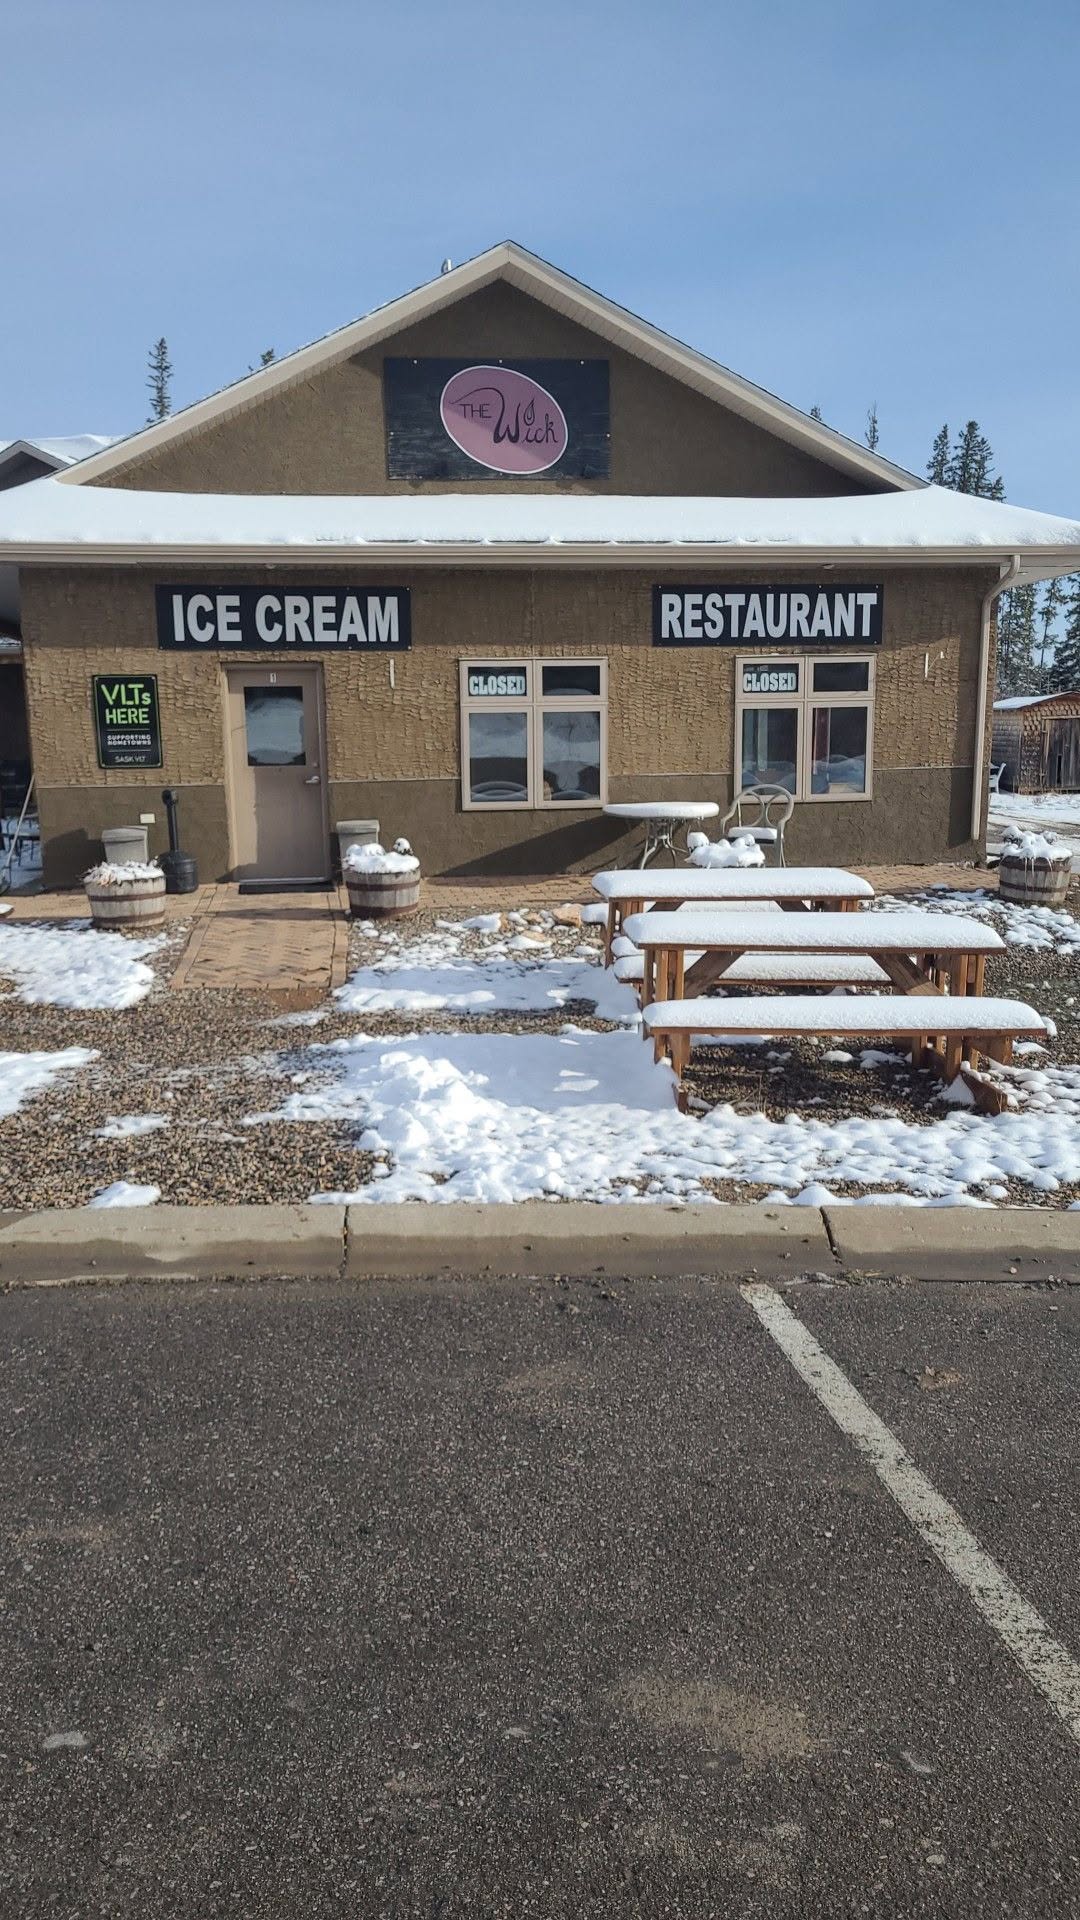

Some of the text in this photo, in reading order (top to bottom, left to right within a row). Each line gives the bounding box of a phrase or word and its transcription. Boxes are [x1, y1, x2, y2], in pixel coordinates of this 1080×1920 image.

[459, 403, 492, 419] THE
[172, 594, 399, 642] ICE CREAM
[661, 592, 878, 638] RESTAURANT
[469, 675, 526, 695] CLOSED
[743, 672, 797, 692] CLOSED
[101, 684, 151, 705] VLTs
[105, 708, 150, 724] HERE
